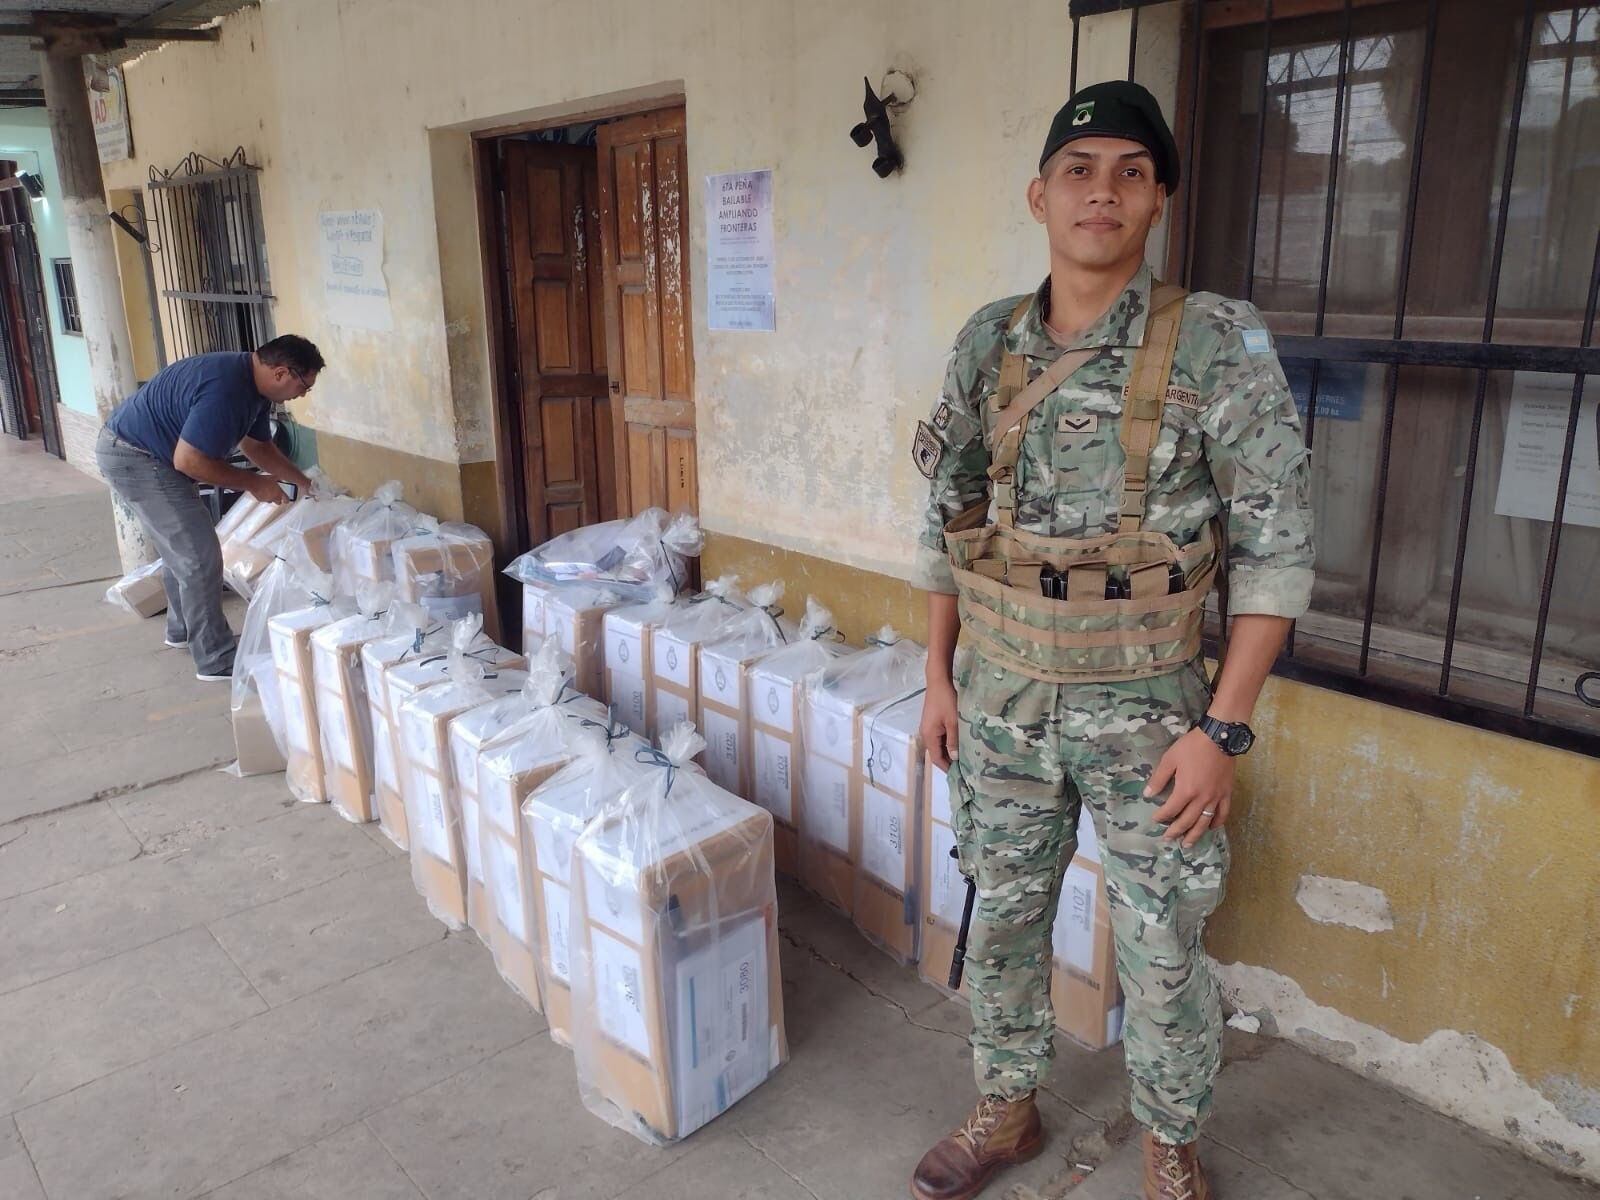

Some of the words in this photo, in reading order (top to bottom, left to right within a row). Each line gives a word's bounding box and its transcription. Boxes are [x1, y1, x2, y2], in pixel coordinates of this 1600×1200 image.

[735, 178, 753, 191] PEÑA
[722, 194, 752, 206] BAILABLE
[719, 208, 758, 220] AMPLIANDO
[720, 222, 757, 233] FRONTERAS
[1165, 389, 1199, 407] ARGENTI
[888, 815, 898, 849] 3105
[1071, 885, 1085, 924] 3107
[739, 961, 749, 994] 3080
